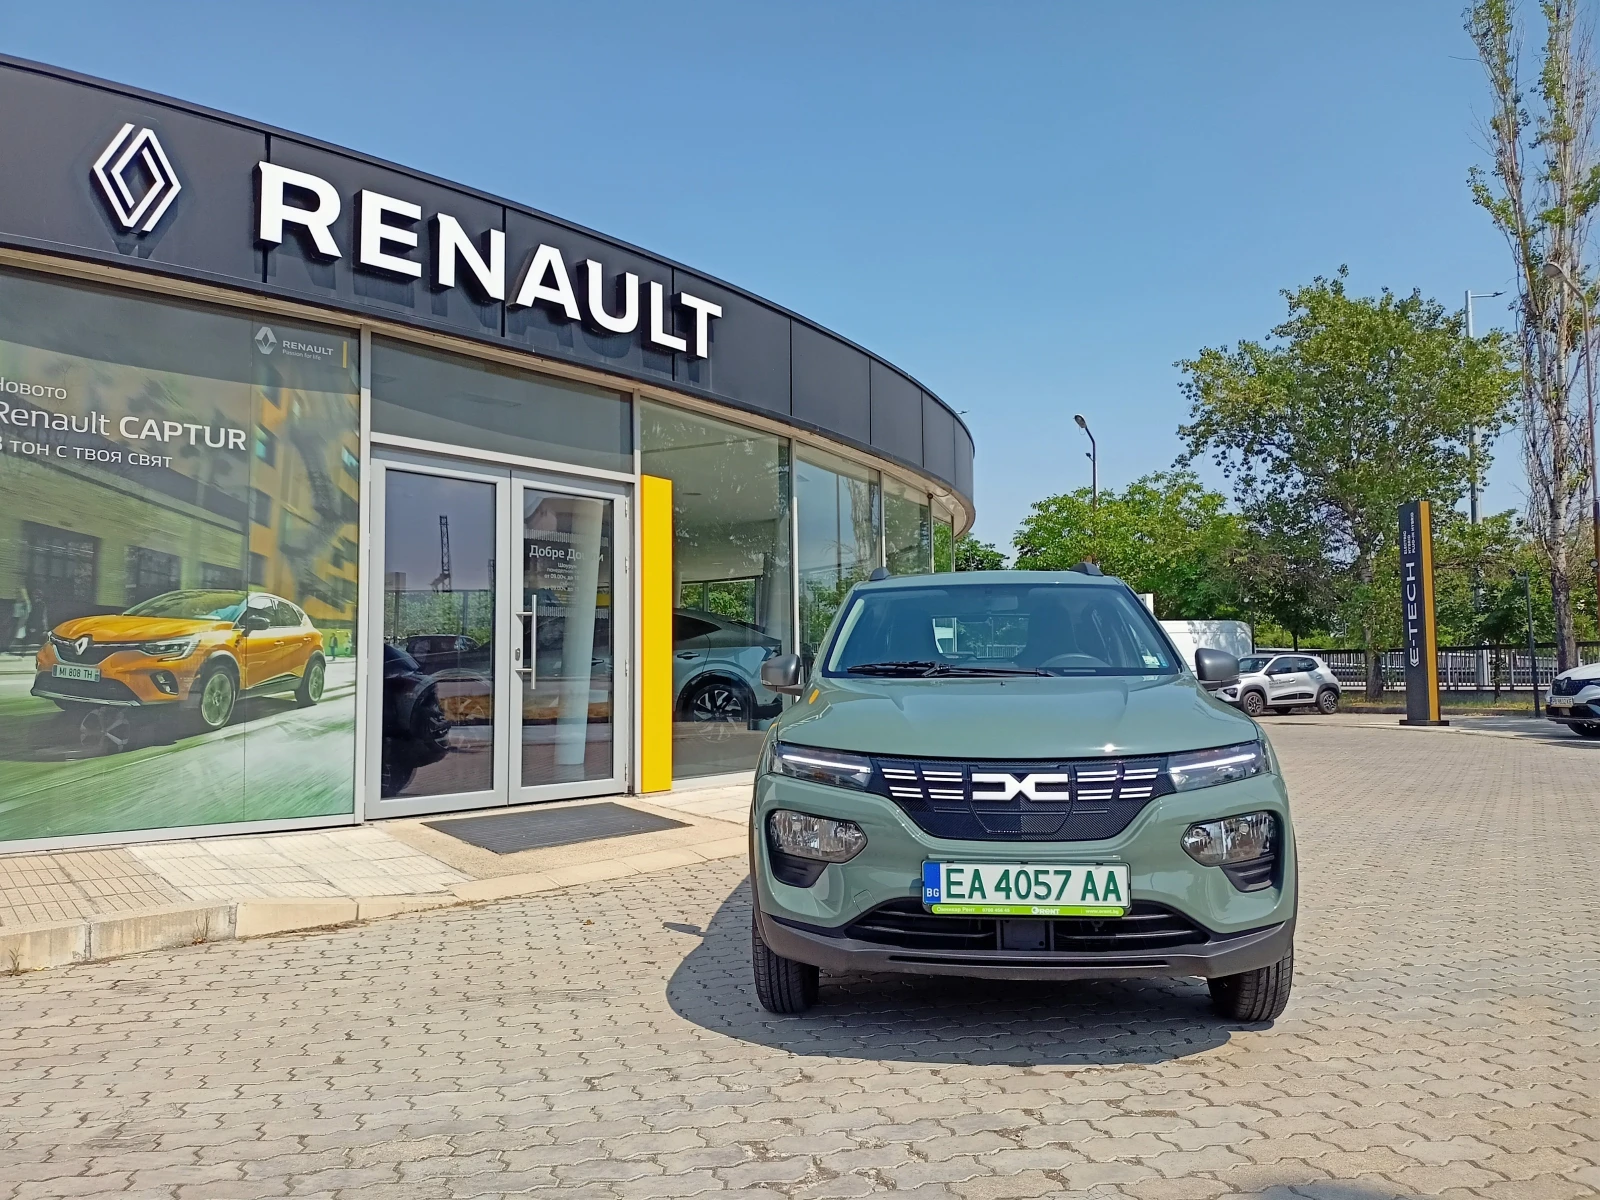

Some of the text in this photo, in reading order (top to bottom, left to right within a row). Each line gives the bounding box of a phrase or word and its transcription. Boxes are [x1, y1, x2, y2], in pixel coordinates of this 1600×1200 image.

[258, 161, 722, 359] RENAULT
[282, 340, 334, 356] RENAULT
[282, 349, 303, 358] Passion
[0, 401, 247, 451] Renault CAPTUR
[529, 545, 565, 560] Добре
[1406, 562, 1420, 668] E-TECH
[59, 667, 67, 677] MI
[84, 669, 93, 679] TH
[926, 888, 940, 898] BG
[945, 868, 1122, 902] EA 4057 AA
